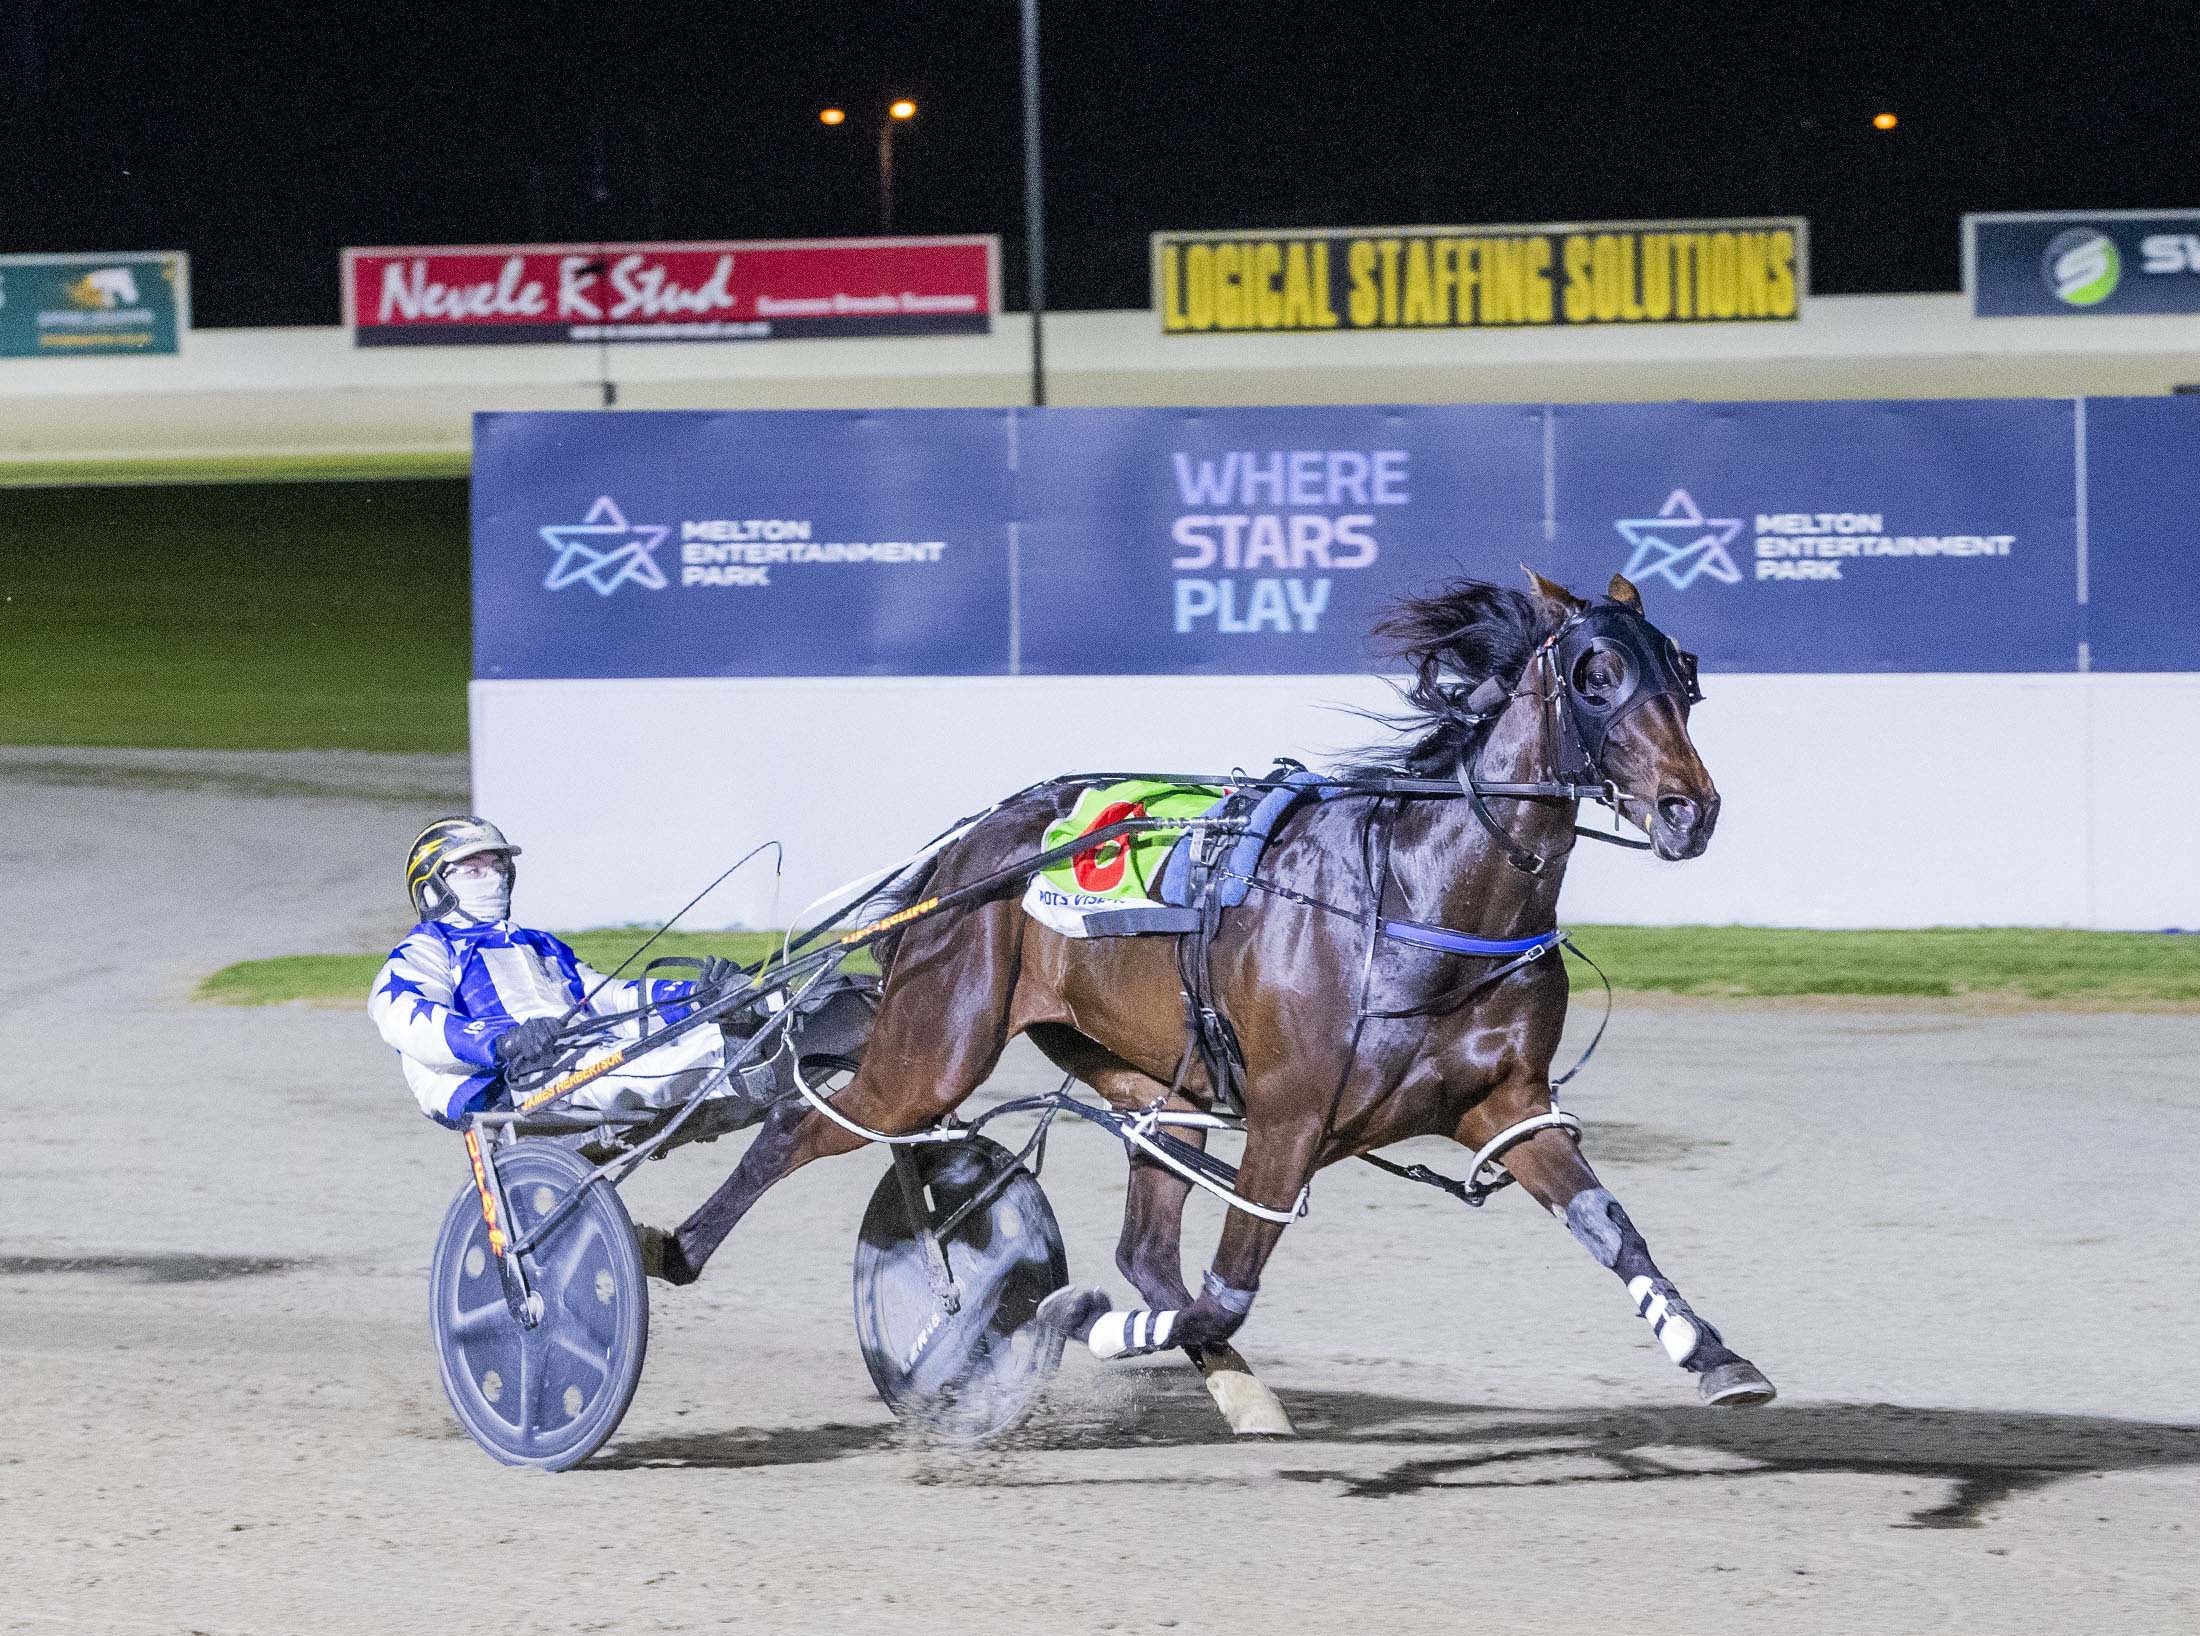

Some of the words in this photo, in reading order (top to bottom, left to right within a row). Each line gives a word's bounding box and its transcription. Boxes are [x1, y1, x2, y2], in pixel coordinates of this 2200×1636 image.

[378, 256, 547, 322] Nevele
[609, 254, 733, 319] Stud
[1165, 242, 1338, 330] LOGICAL
[1348, 236, 1553, 326] STAFFING
[1563, 230, 1797, 323] SOLUTIONS
[1172, 450, 1411, 505] WHERE
[681, 520, 811, 541] MELTON
[1170, 514, 1380, 569] STARS
[1754, 513, 1884, 535] MELTON
[681, 541, 946, 564] ENTERTAINMENT
[1754, 535, 2016, 558] ENTERTAINMENT
[681, 566, 771, 587] PARK
[1754, 560, 1843, 581] PARK
[1174, 578, 1332, 633] PLAY
[521, 1086, 557, 1111] JAMES
[557, 1050, 624, 1095] HERBERTSON
